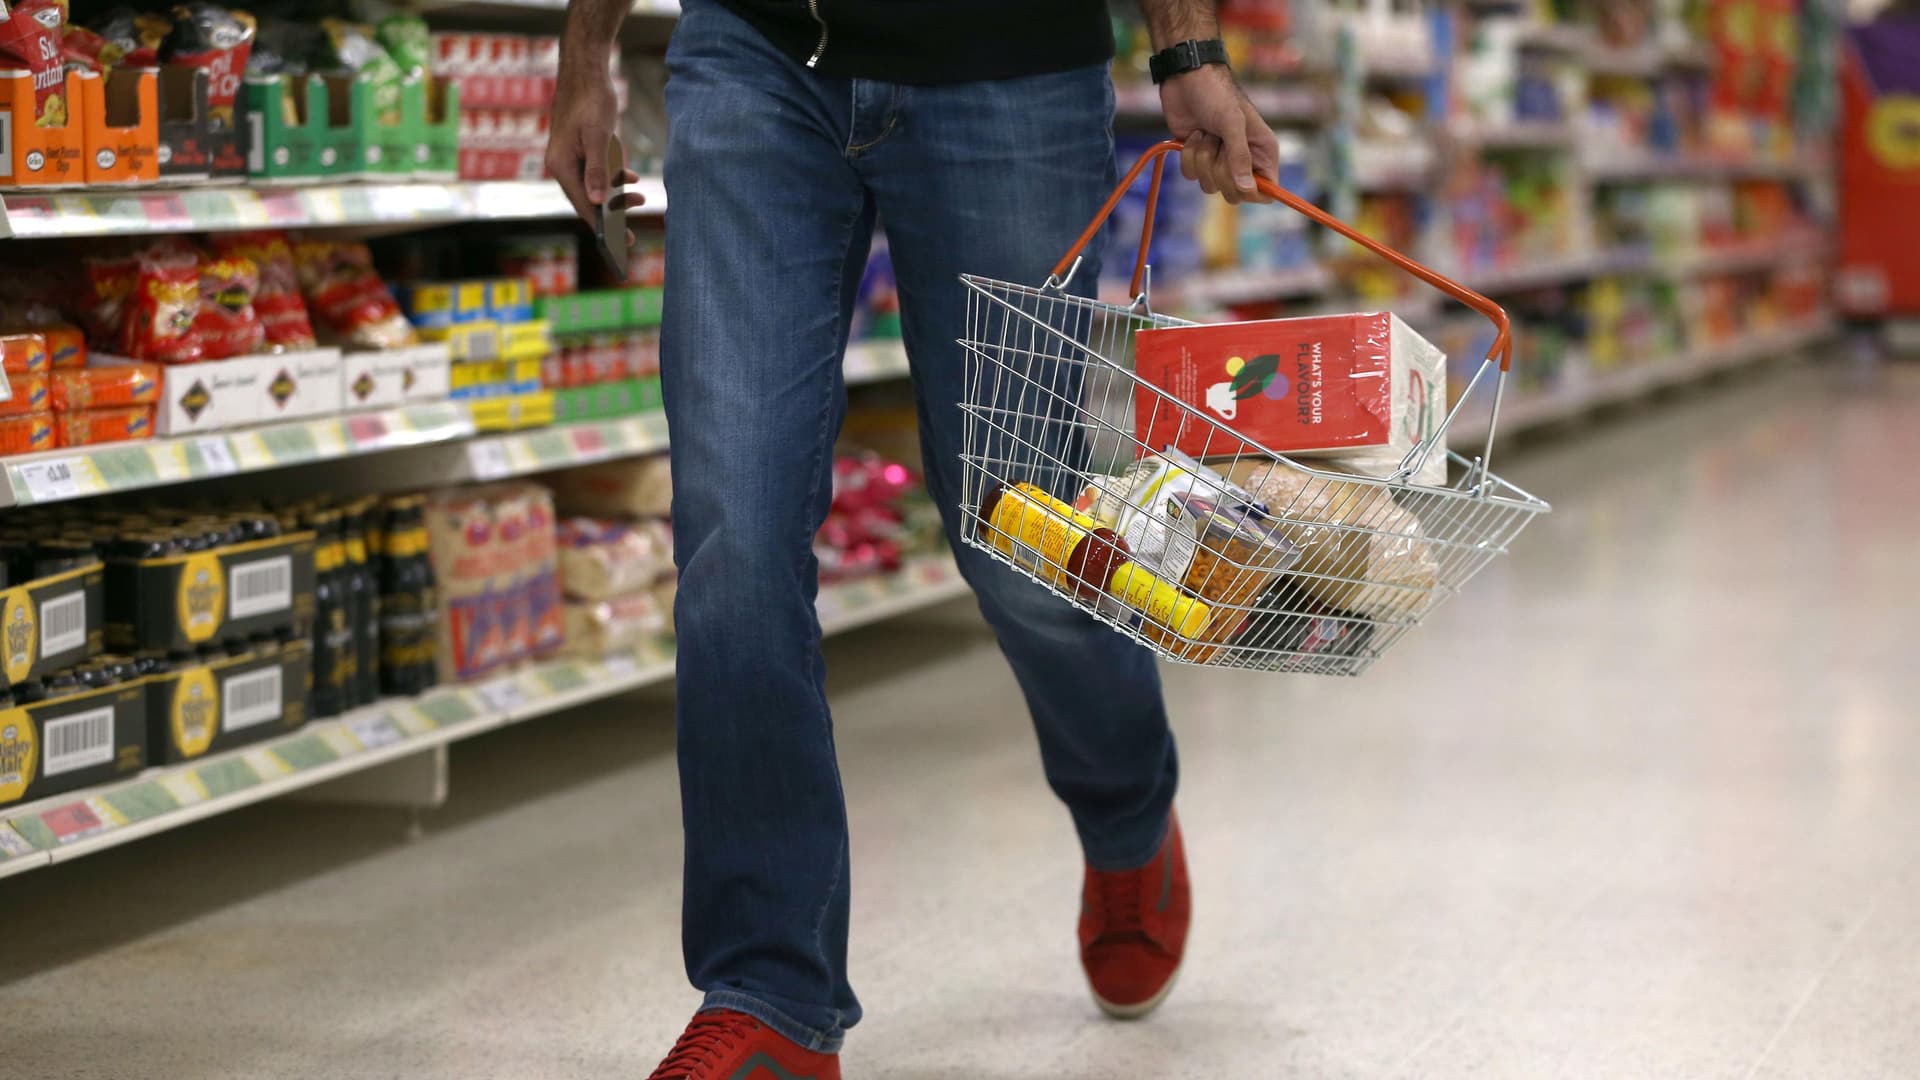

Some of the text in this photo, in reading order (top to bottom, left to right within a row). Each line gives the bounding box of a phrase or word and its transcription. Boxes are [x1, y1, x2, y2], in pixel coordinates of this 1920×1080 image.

[1297, 343, 1310, 425] FLAVOUR?
[1311, 342, 1322, 425] WHAT'S YOUR
